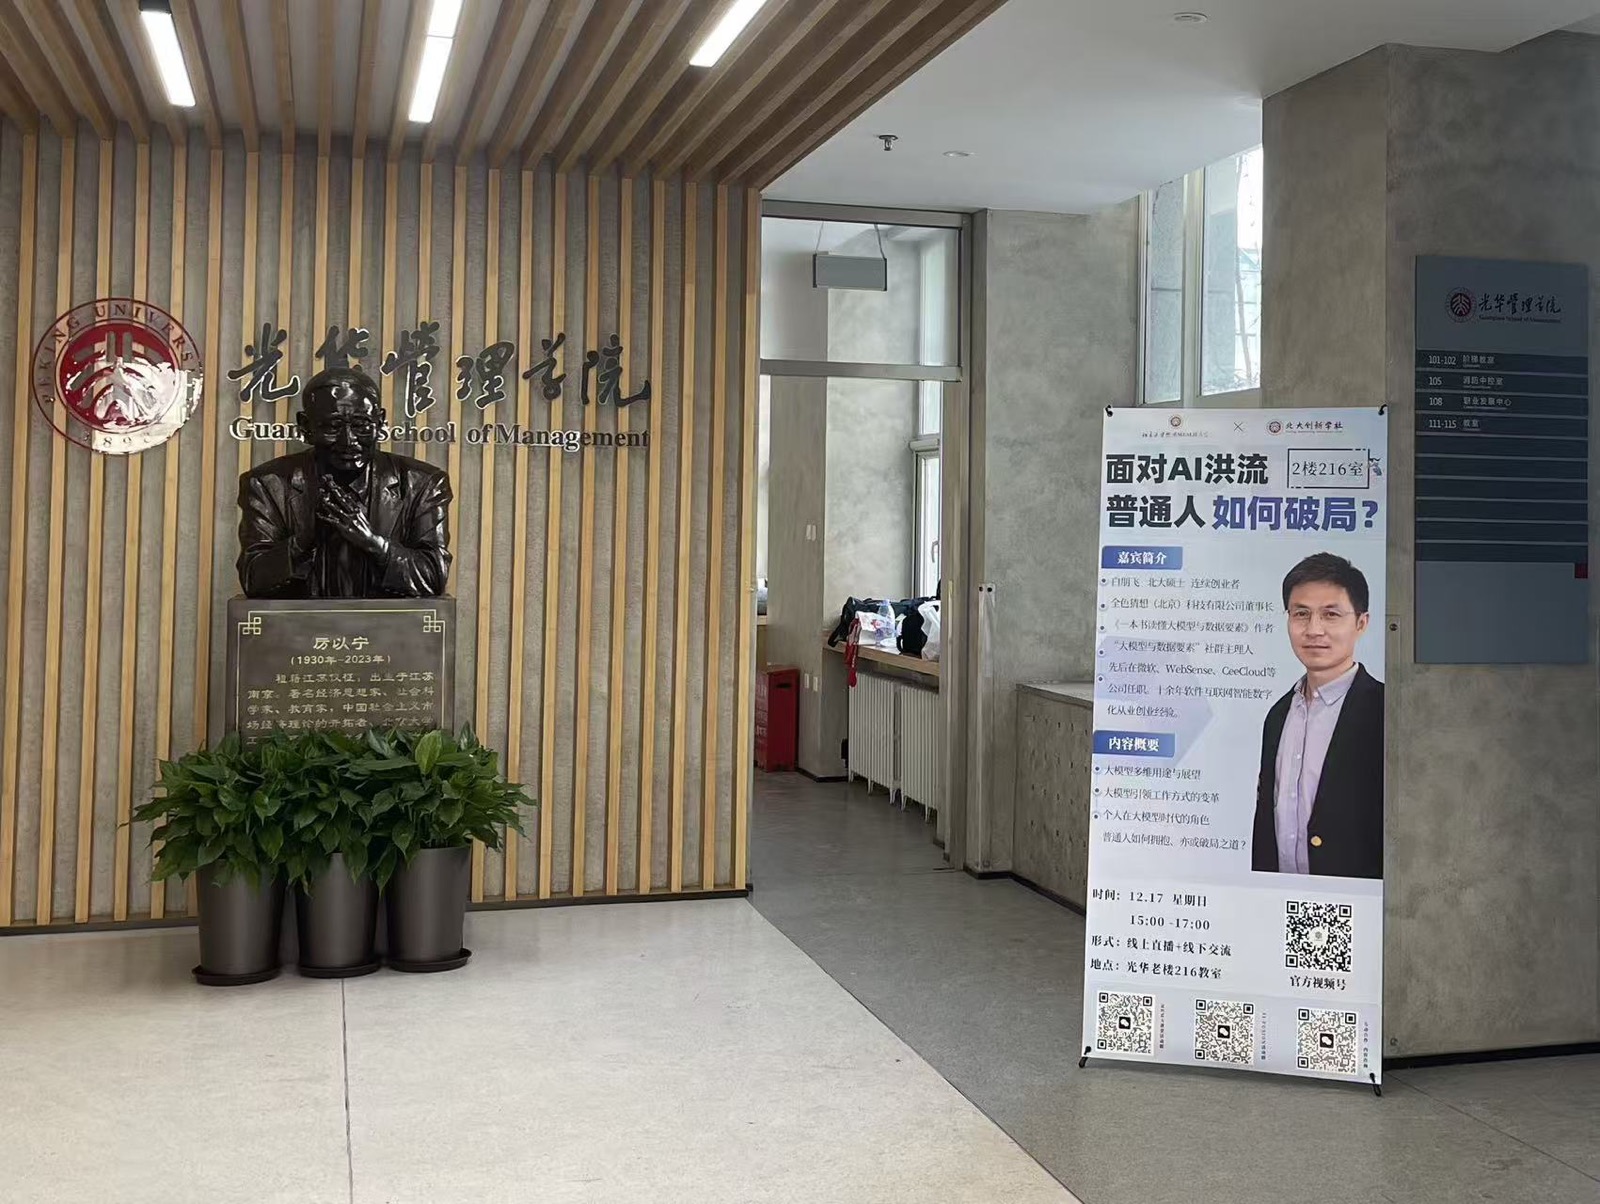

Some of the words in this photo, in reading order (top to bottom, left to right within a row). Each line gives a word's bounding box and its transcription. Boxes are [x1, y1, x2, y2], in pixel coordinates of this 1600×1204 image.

[1478, 292, 1562, 315] 光华管理学院
[1429, 355, 1456, 365] 101-102
[1429, 376, 1442, 386] 105
[1429, 397, 1443, 406] 108
[230, 417, 304, 442] Guan
[467, 423, 490, 443] of
[495, 424, 650, 452] Management
[1106, 453, 1269, 485] 面对AI洪流
[1291, 460, 1364, 477] 2楼216室
[1106, 494, 1379, 532] 普通人如何破局？
[1117, 550, 1167, 566] 嘉宾简介
[313, 636, 370, 651] 厉以宁
[1108, 736, 1160, 752] 内容概要
[1104, 766, 1201, 781] 大模型多维用途与展望
[1104, 786, 1220, 803] 大模型引领工作方式的变革
[1103, 809, 1210, 826] 个人在大模型时代的角色
[1173, 893, 1208, 907] 星期日
[1290, 975, 1347, 991] 官方视频号
